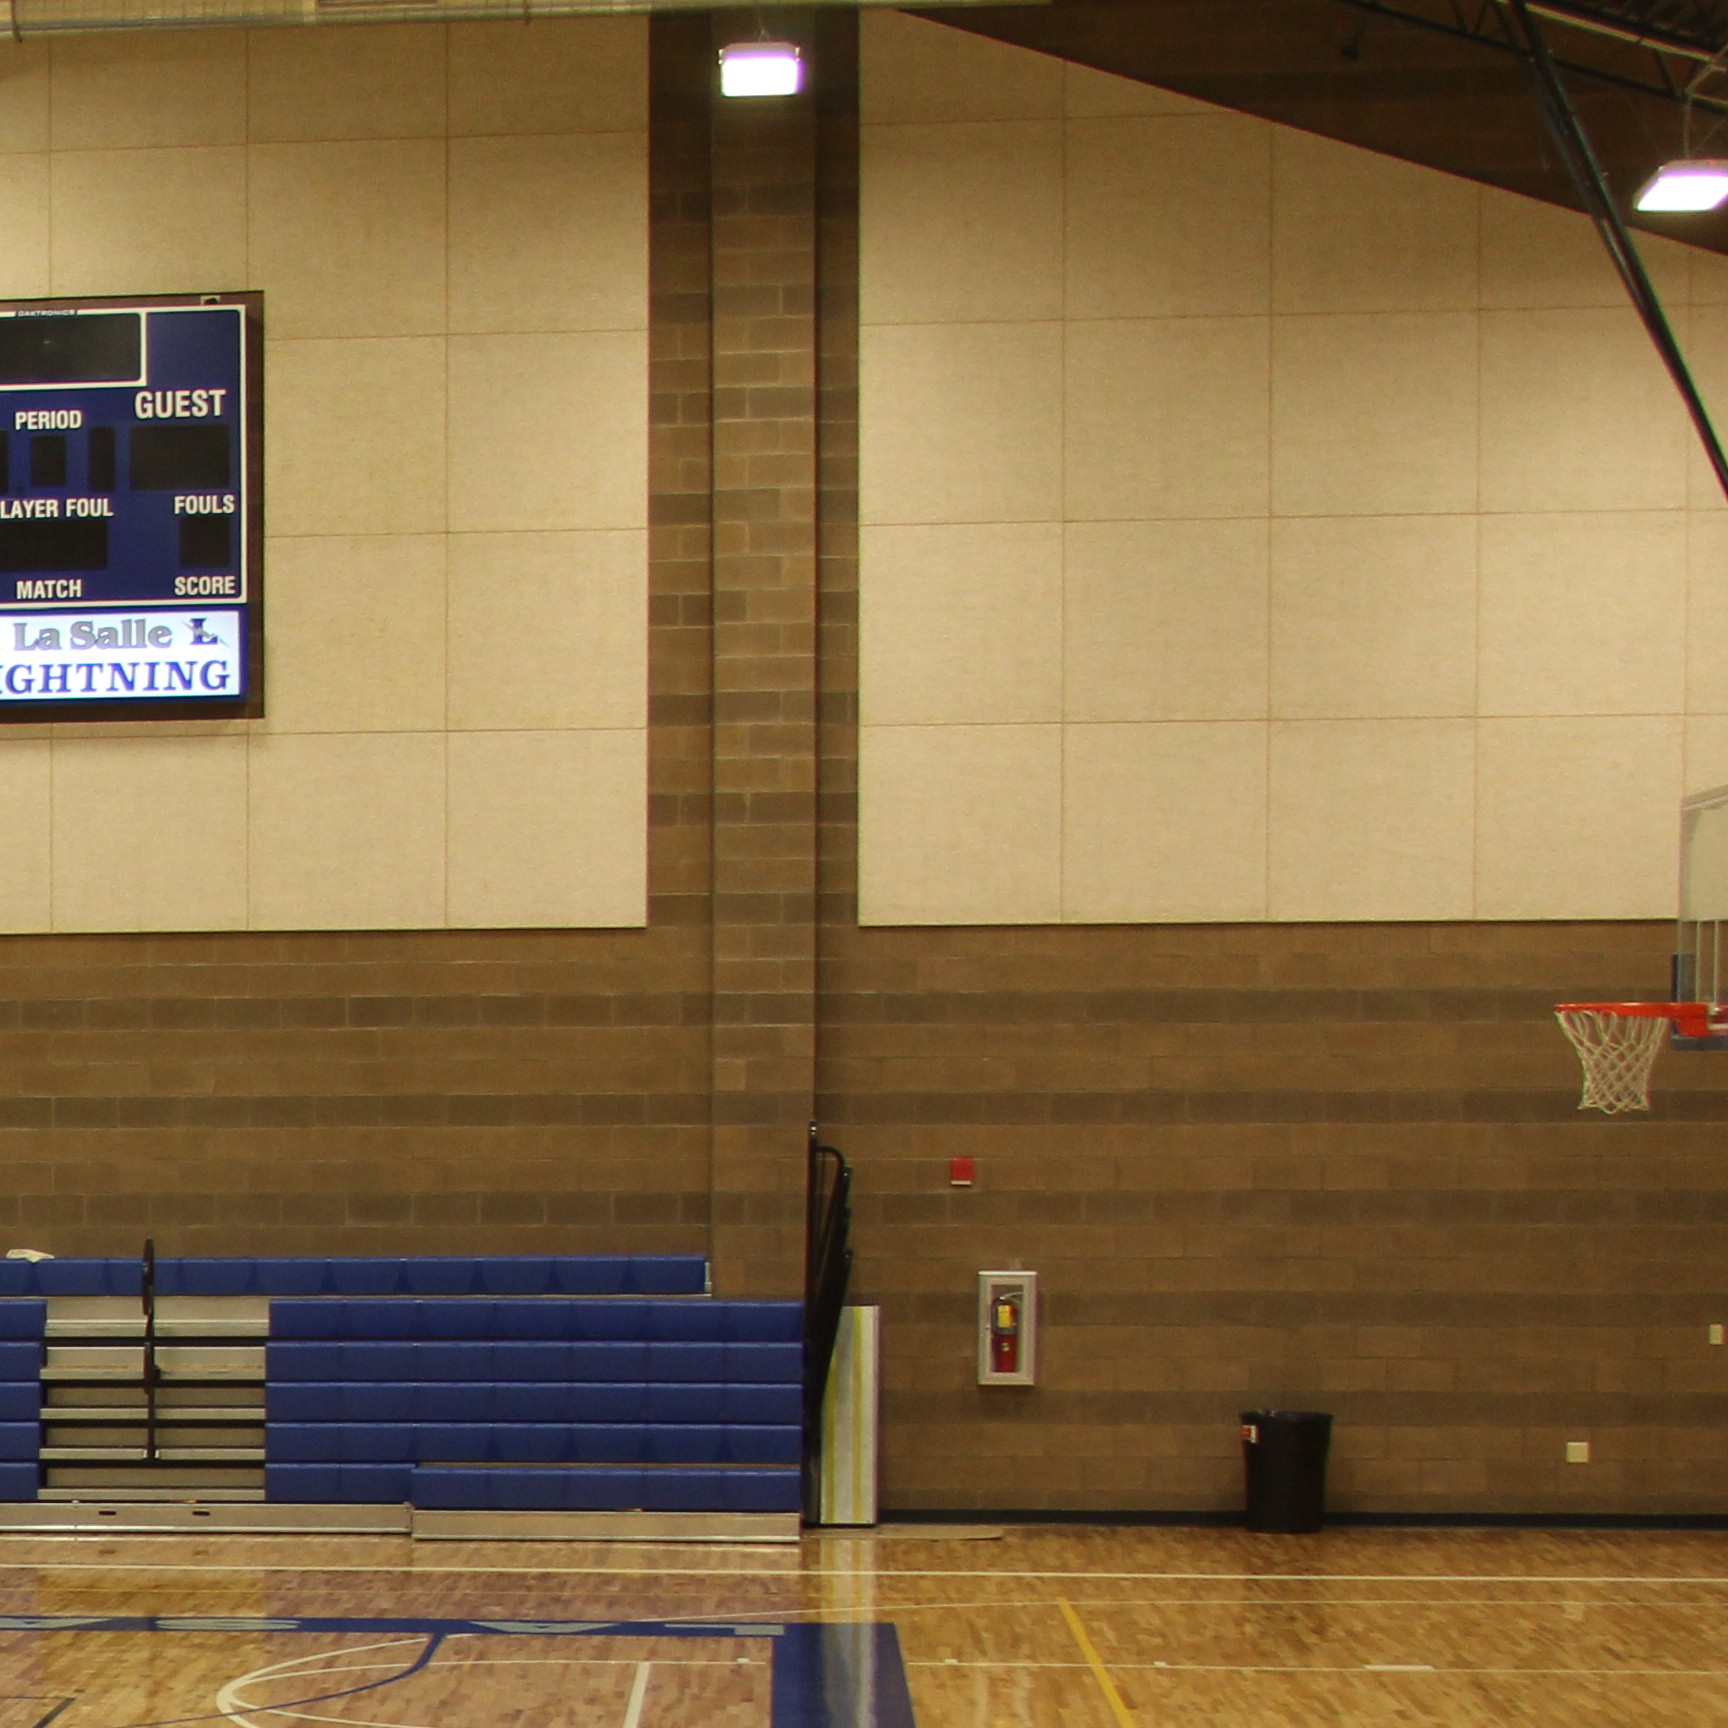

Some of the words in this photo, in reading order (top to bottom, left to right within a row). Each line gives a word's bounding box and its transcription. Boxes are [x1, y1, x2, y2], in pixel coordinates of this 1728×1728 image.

[134, 388, 227, 420] GUEST
[15, 409, 83, 431] PERIOD
[65, 497, 115, 518] FOUL
[173, 494, 236, 515] FOULS
[15, 578, 83, 600] MATCH
[173, 575, 236, 597] SCORE
[13, 621, 63, 652] La
[69, 618, 174, 651] Salle
